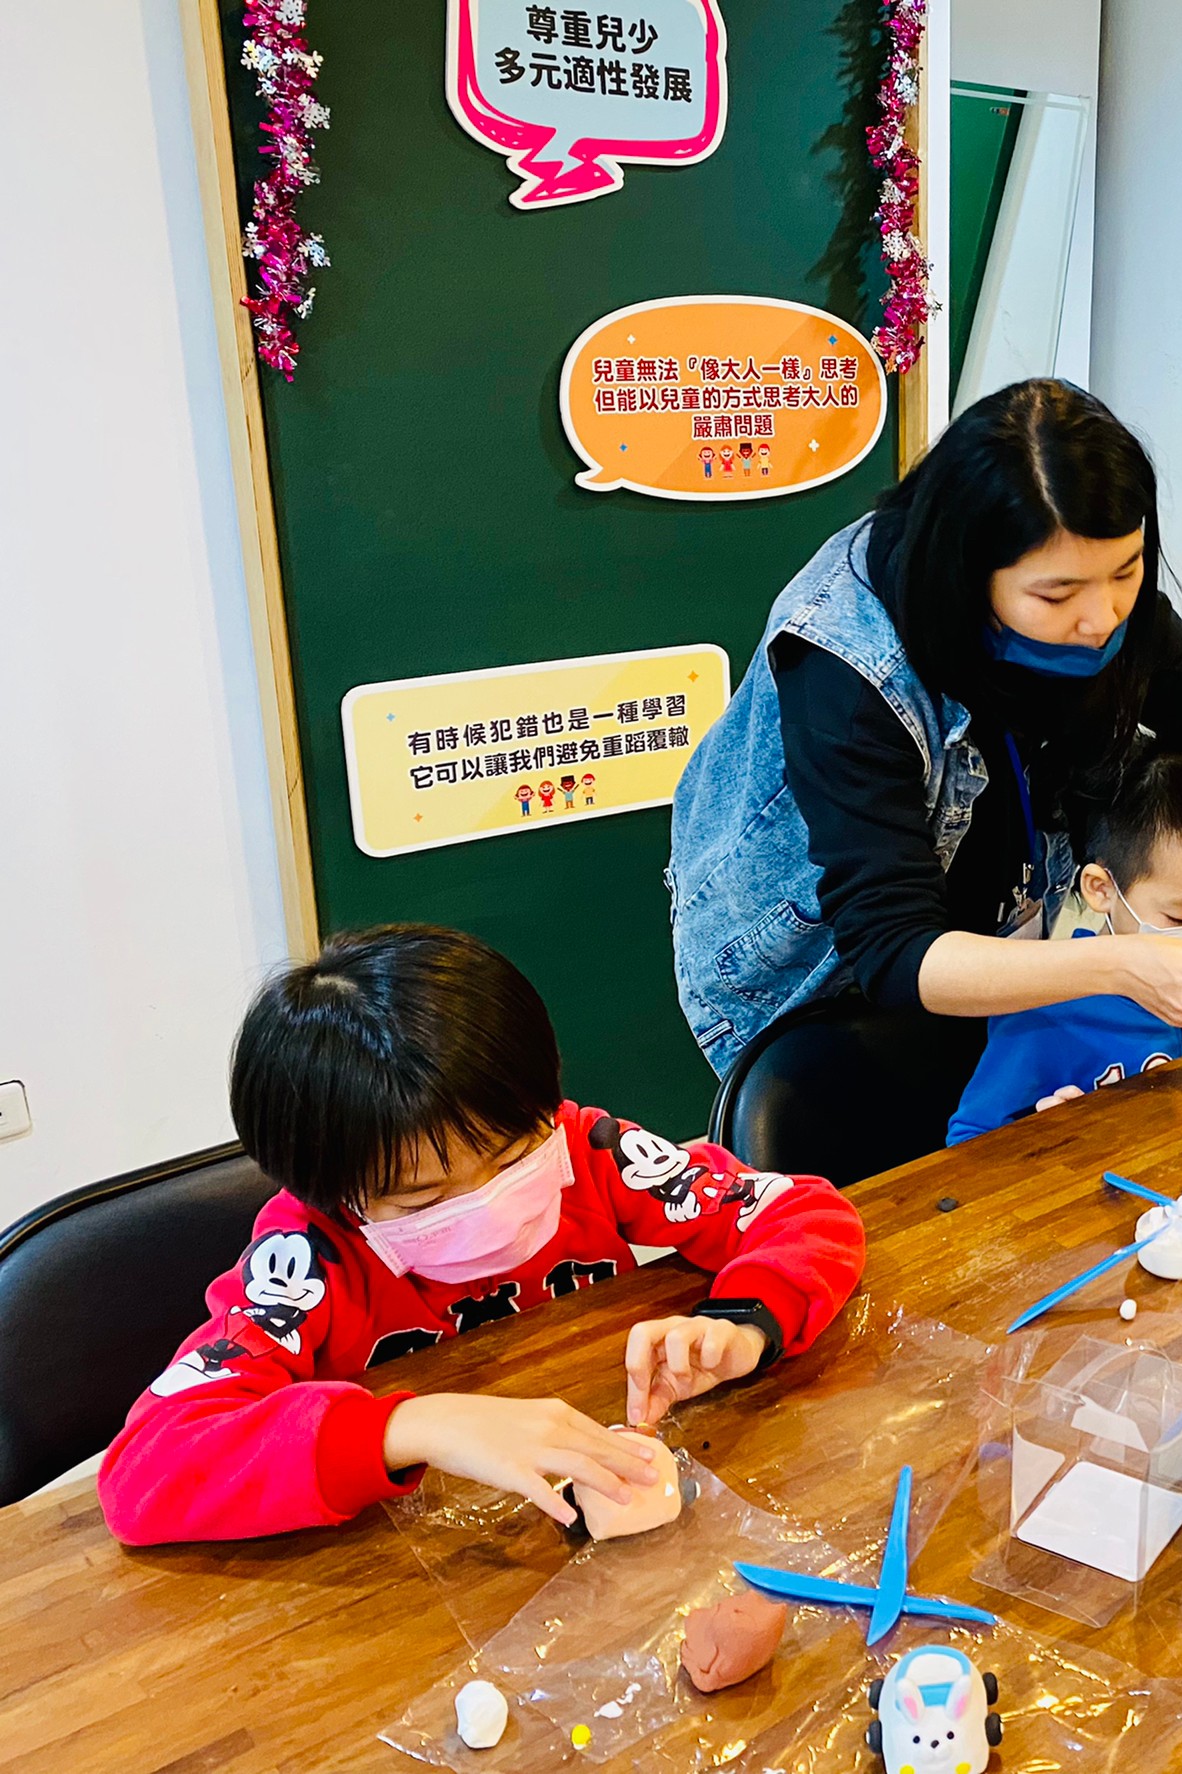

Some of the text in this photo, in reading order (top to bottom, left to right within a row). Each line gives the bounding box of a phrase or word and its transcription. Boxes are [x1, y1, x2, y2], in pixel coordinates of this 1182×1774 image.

[525, 4, 659, 54] 尊重兒少
[494, 47, 693, 103] 多元適性發展
[595, 385, 857, 412] 但能以兒童的方式思考大人的
[692, 414, 774, 438] 嚴肅問題
[407, 694, 687, 756] 有時候犯錯也是一種學習
[410, 724, 691, 790] 它可以讓我們避免重蹈覆轍
